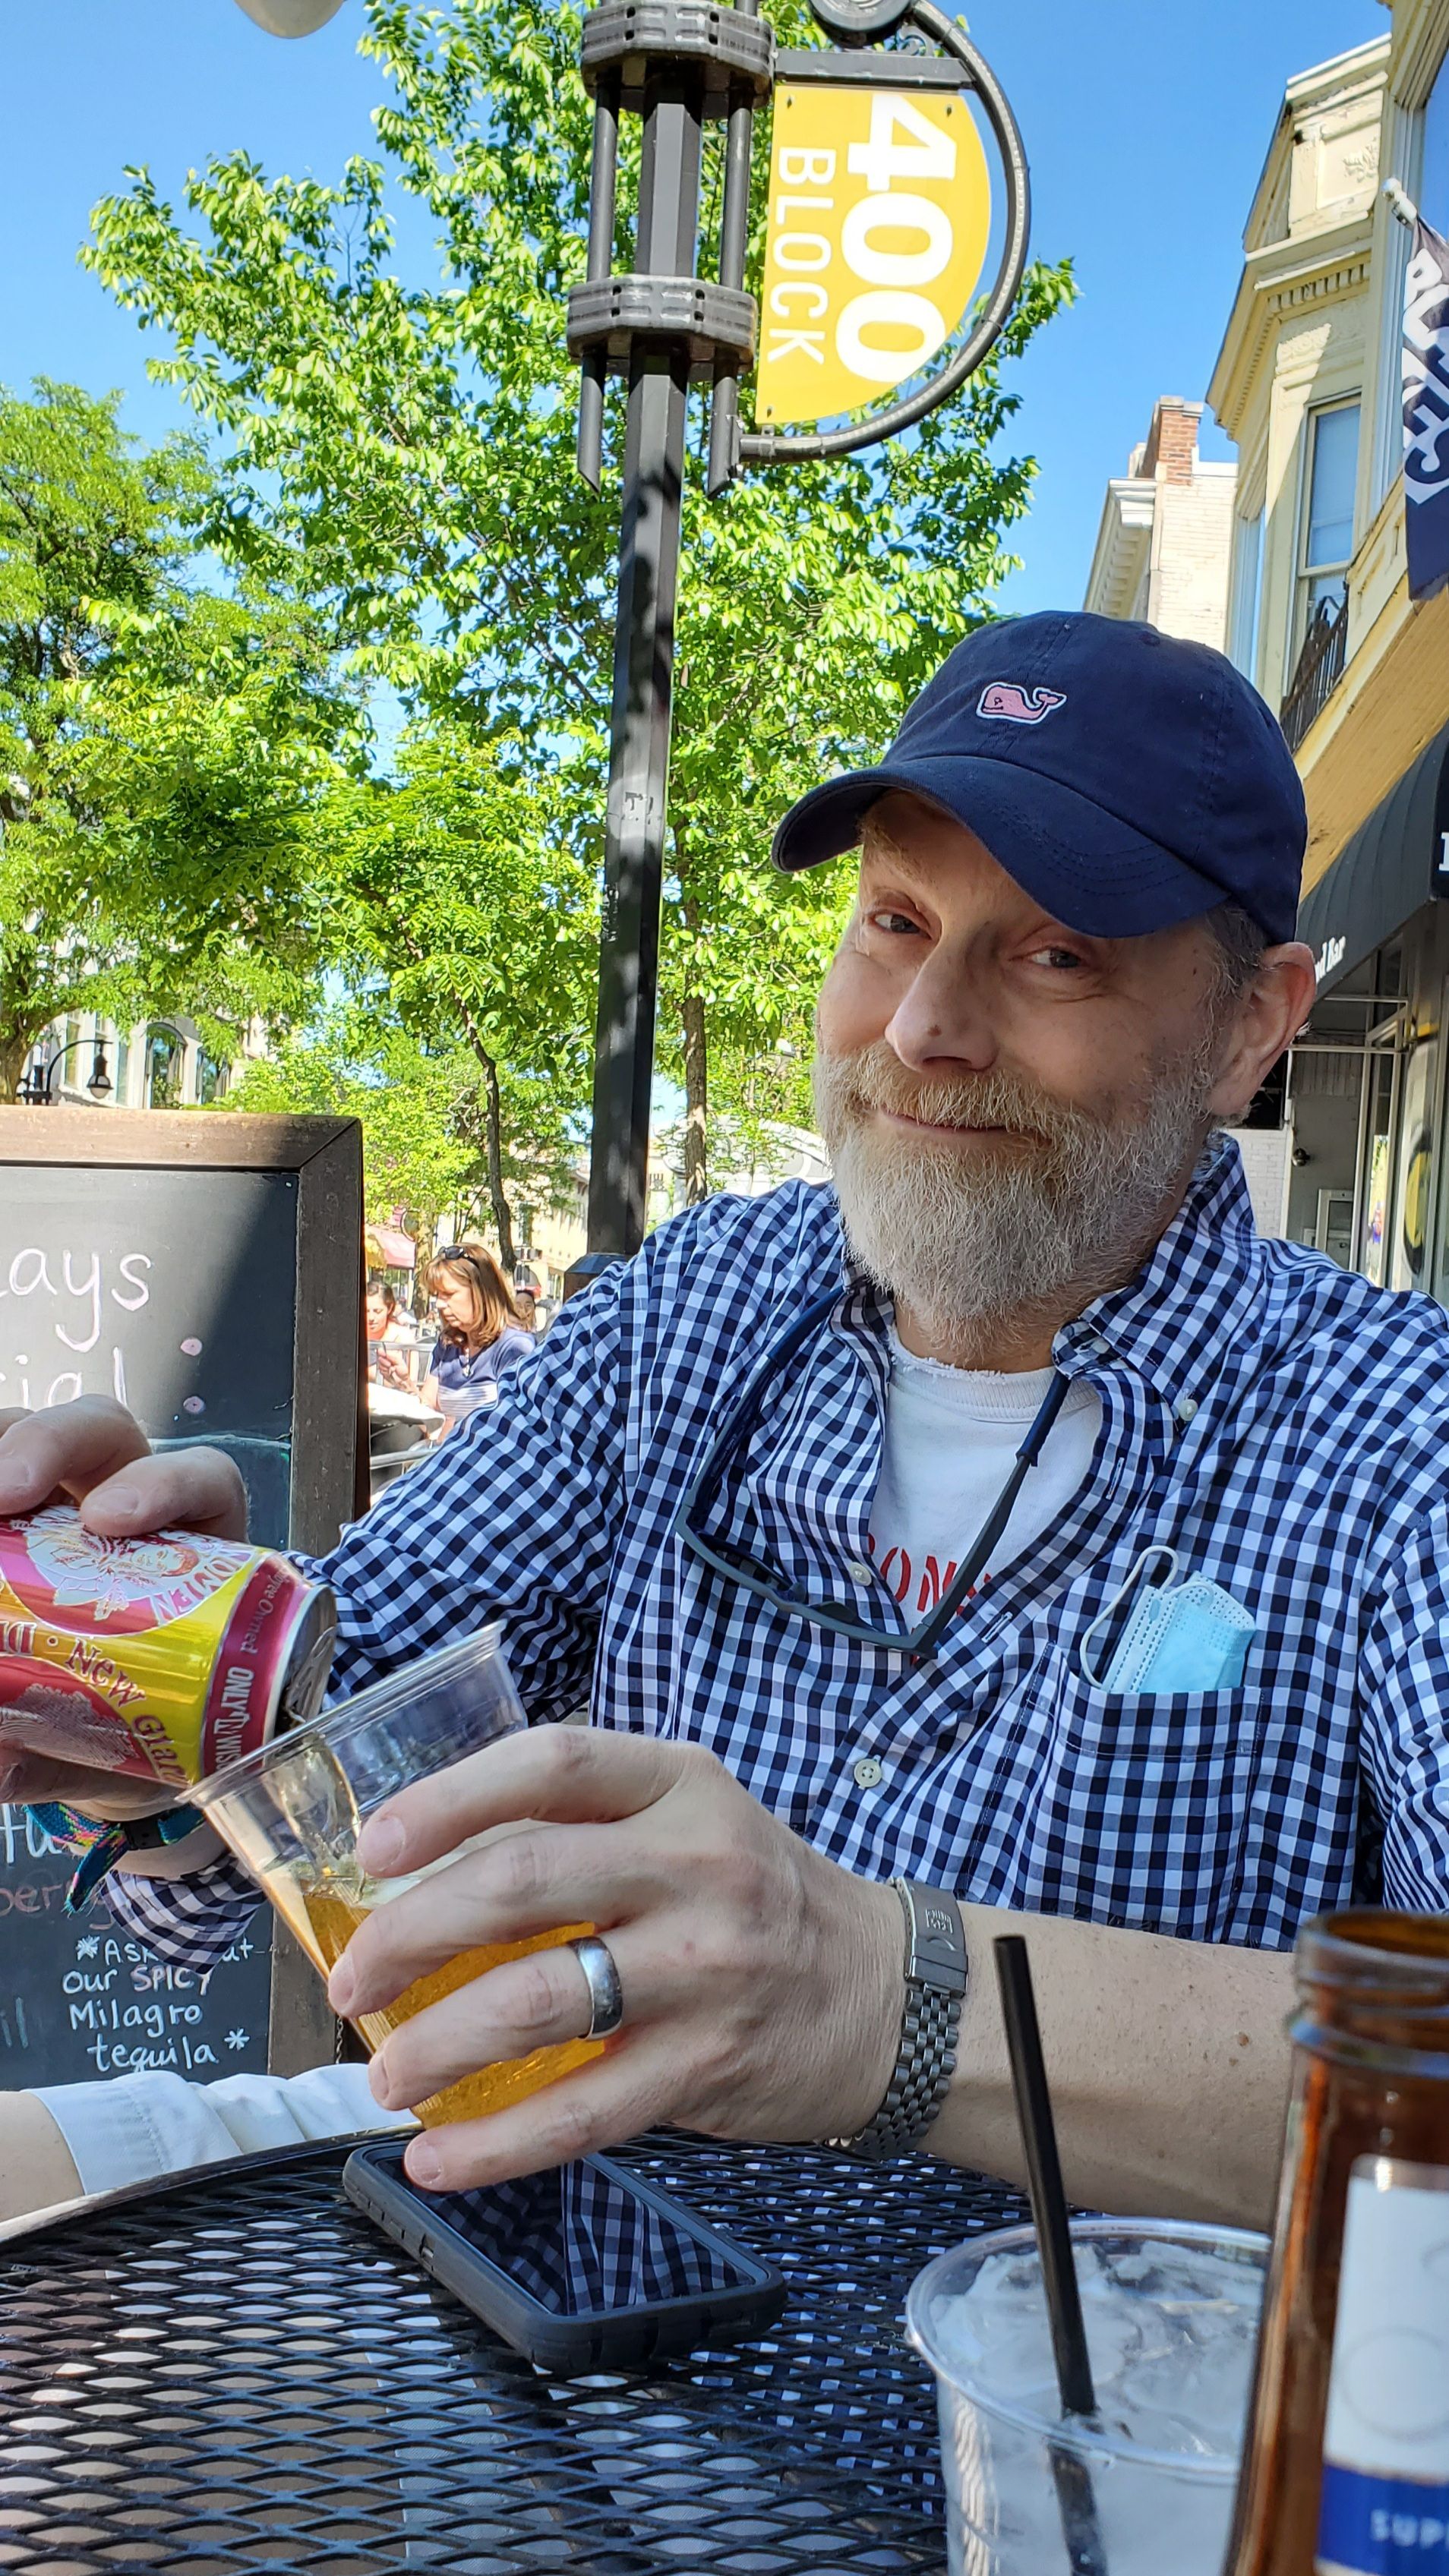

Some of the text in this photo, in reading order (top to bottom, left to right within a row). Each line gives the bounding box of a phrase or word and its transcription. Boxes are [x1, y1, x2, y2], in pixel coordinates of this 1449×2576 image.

[769, 147, 835, 364] BLOCK
[837, 94, 957, 382] 400
[240, 1597, 274, 1654] Owned
[65, 1638, 147, 1709] New
[220, 1666, 255, 1714] ONLY
[131, 1965, 213, 1997] SPICY
[68, 1998, 204, 2038] Milagro
[86, 2033, 220, 2073] tequila
[1369, 2508, 1449, 2552] SUP
